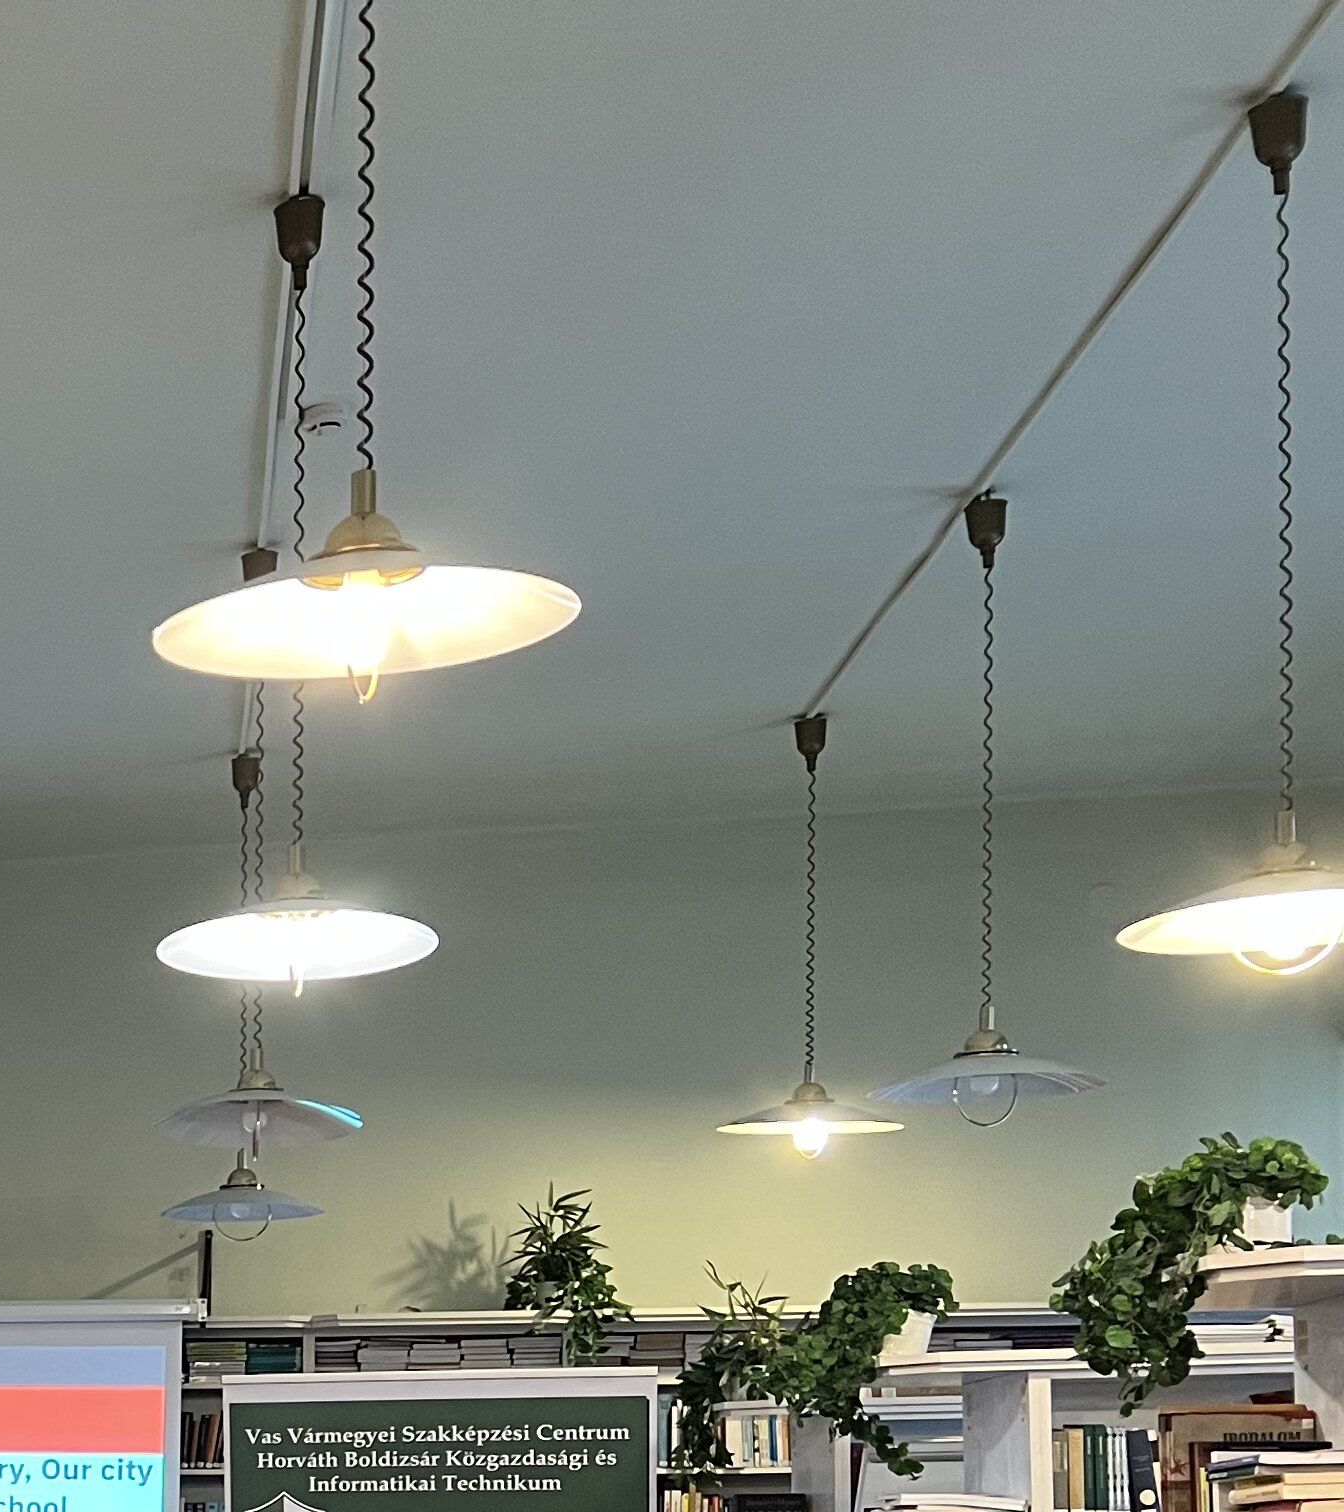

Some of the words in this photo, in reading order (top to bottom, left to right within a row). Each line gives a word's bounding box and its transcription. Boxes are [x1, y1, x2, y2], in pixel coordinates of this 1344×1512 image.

[244, 1428, 283, 1445] Vas
[287, 1426, 396, 1448] Vármegyei
[401, 1423, 530, 1446] Szakképzési
[536, 1423, 630, 1442] Centrum
[256, 1450, 338, 1469] Horváth
[344, 1450, 440, 1468] Boldizsár
[446, 1448, 588, 1470] Közgazdasági
[595, 1447, 618, 1466] és
[41, 1458, 93, 1481] Our
[101, 1457, 154, 1486] city
[308, 1474, 436, 1492] Informatikai
[441, 1474, 562, 1491] Technikum
